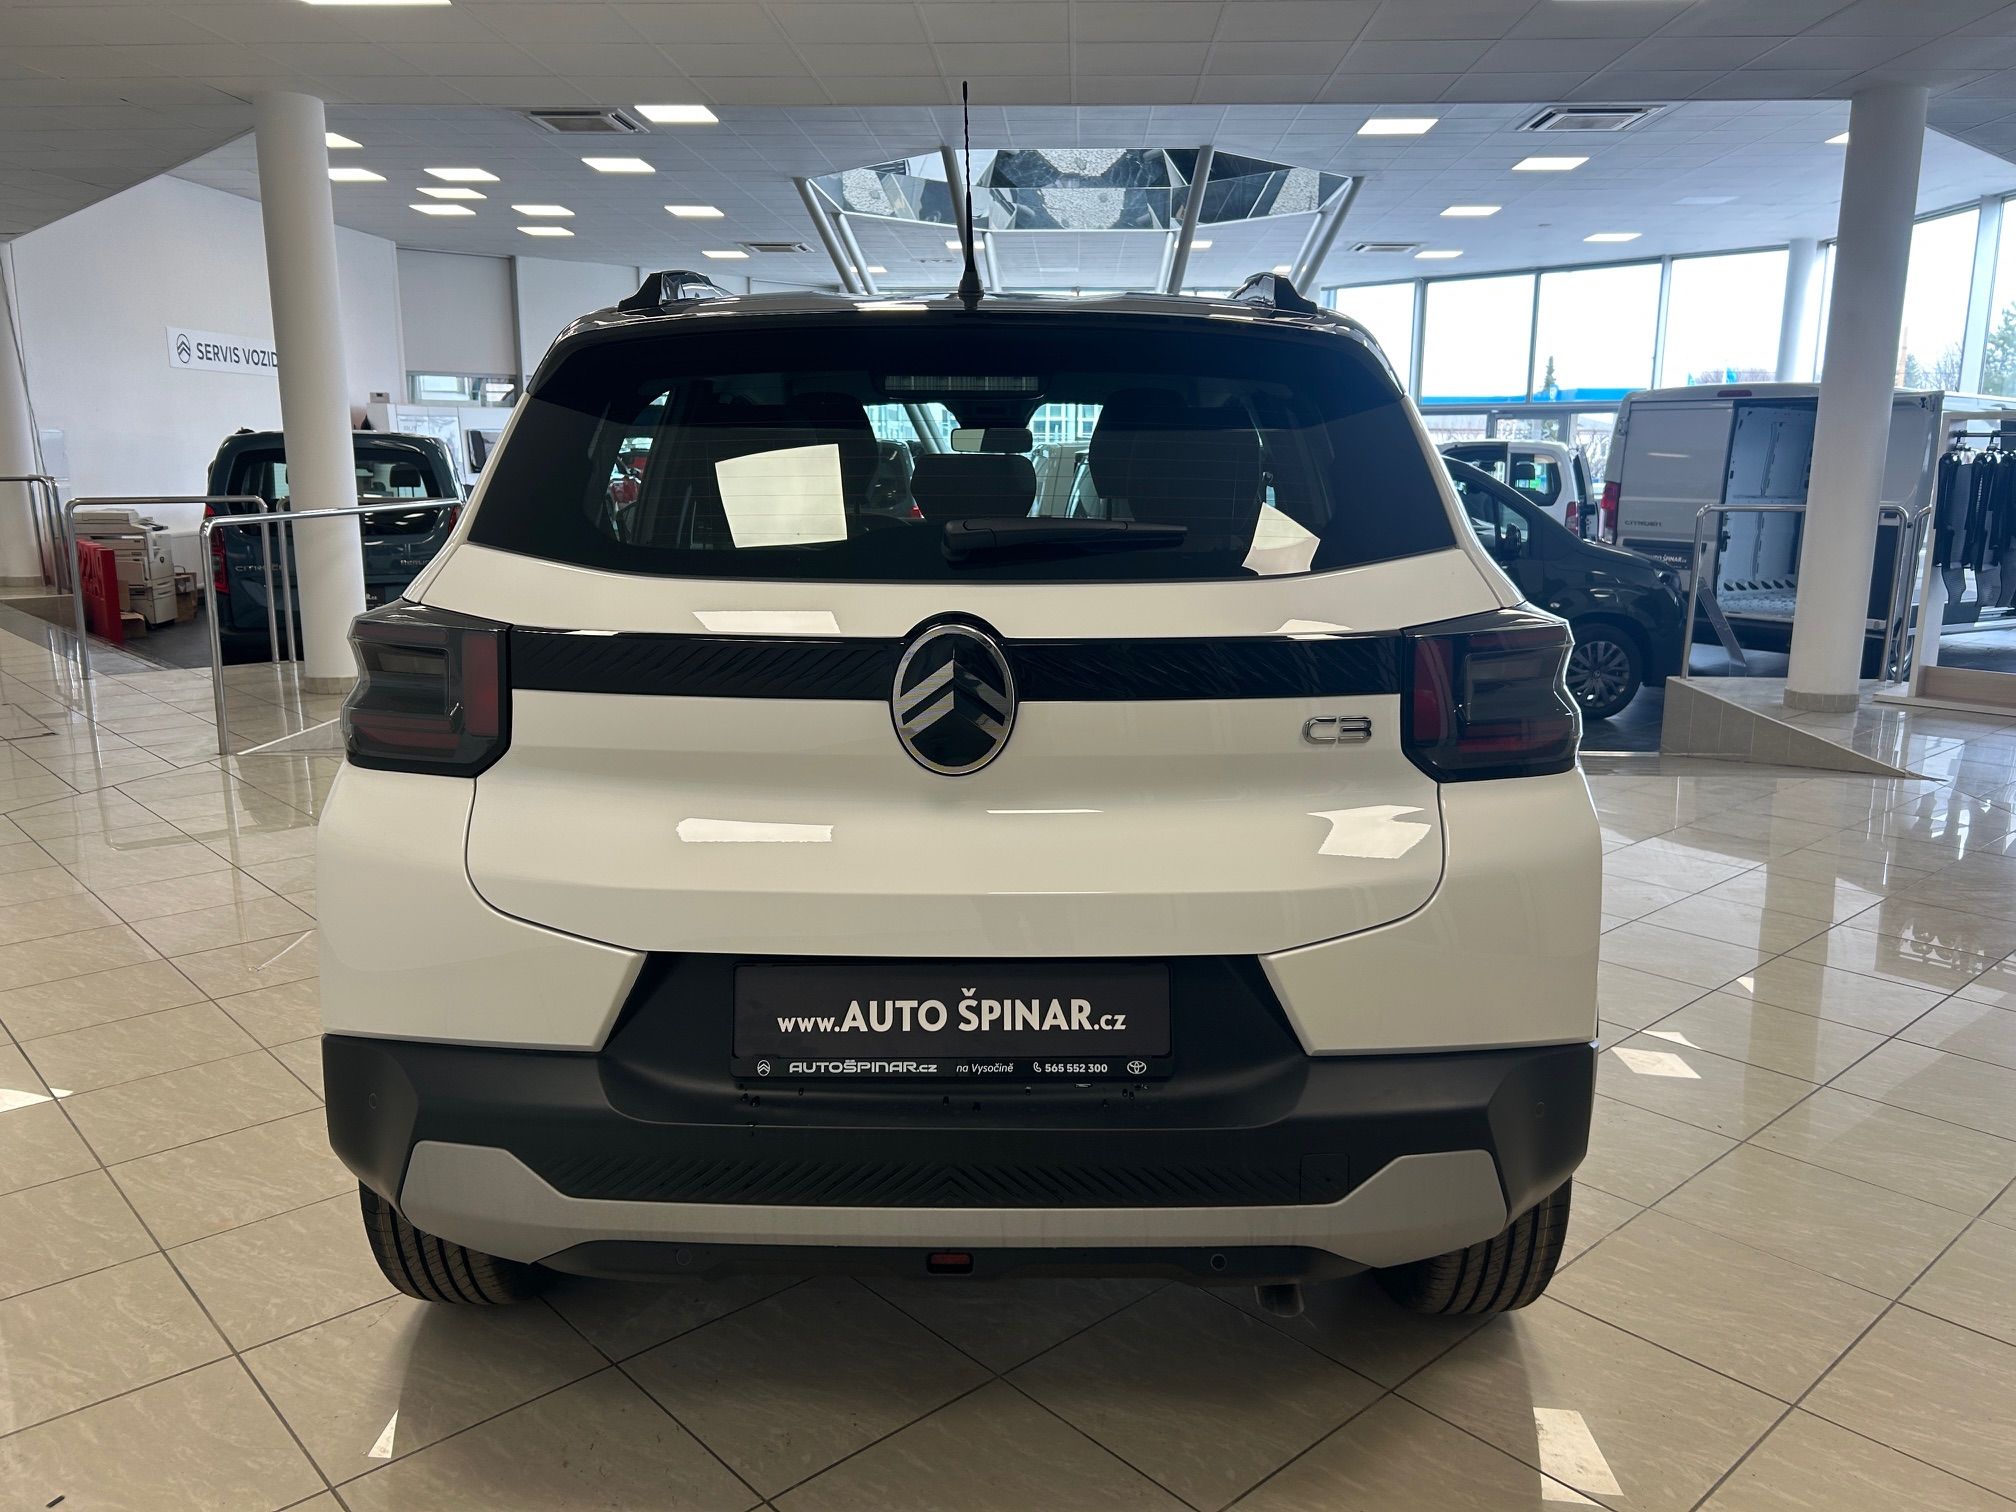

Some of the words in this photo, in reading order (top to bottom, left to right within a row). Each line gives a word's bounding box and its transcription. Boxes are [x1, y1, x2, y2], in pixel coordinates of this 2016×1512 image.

[196, 342, 240, 364] SERVIS
[1301, 715, 1372, 745] C3
[777, 999, 948, 1033] www.AUTO
[958, 987, 1127, 1032] ŠPINAR.cz
[789, 1059, 938, 1073] AUTOŠPINAR.cz
[956, 1065, 969, 1073] na
[971, 1062, 1014, 1075] Vysočině
[1044, 1063, 1065, 1073] 565
[1066, 1063, 1086, 1073] 552
[1088, 1063, 1108, 1073] 300
